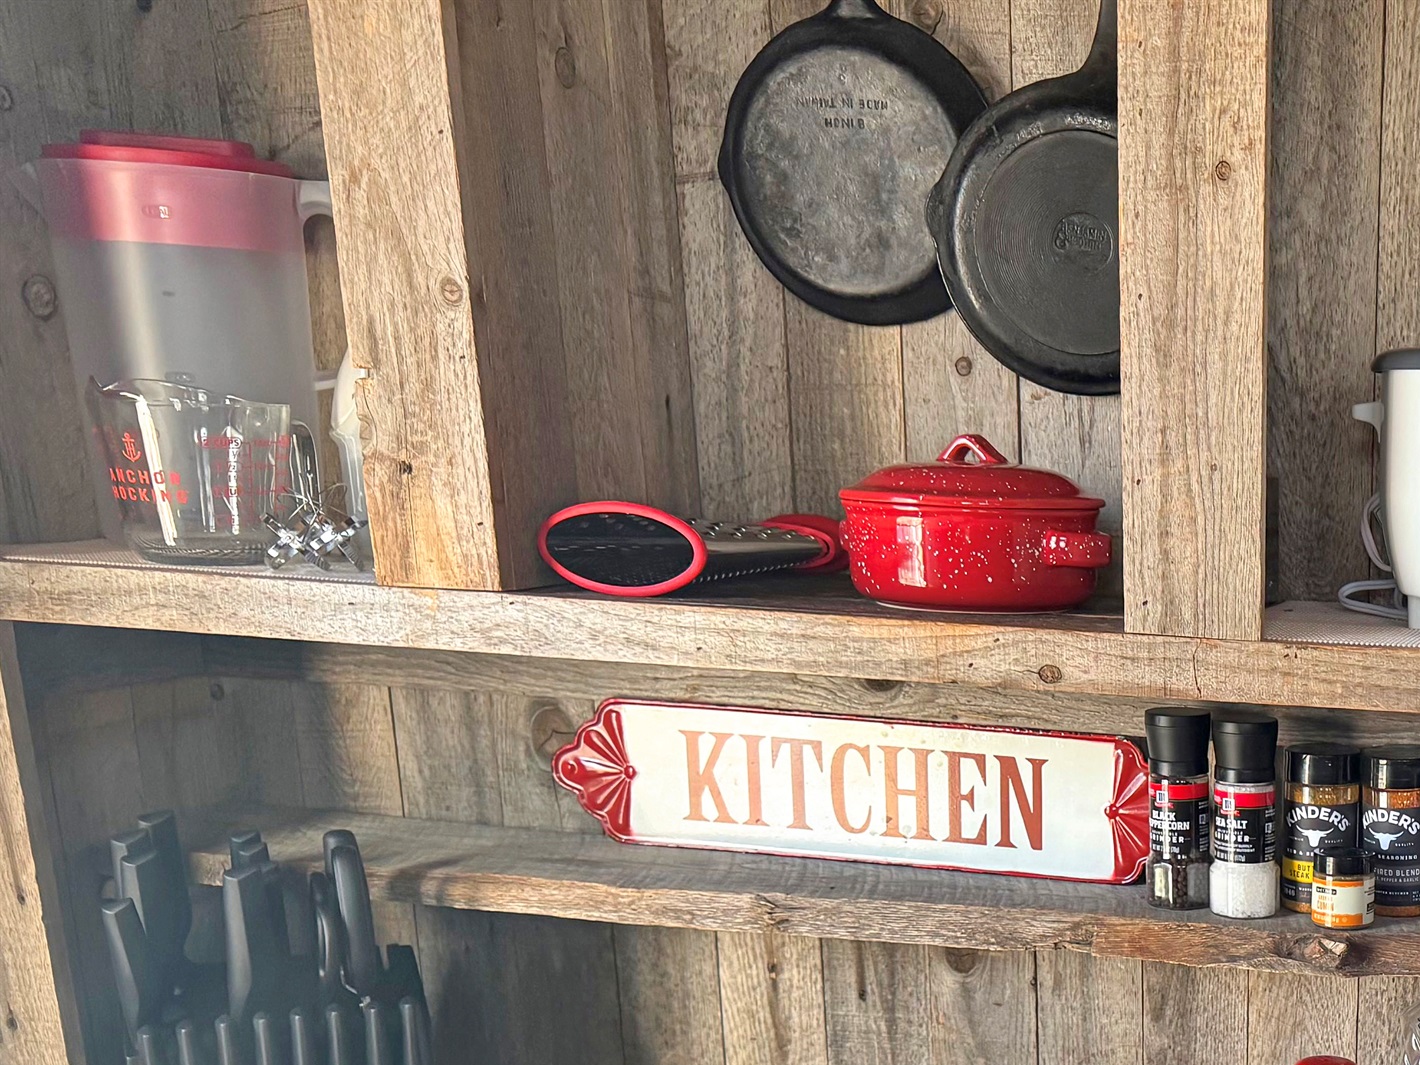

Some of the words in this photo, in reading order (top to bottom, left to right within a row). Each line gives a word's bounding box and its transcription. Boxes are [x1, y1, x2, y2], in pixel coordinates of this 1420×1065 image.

[842, 98, 854, 109] IN
[859, 99, 888, 110] MADE
[825, 118, 854, 129] INCH
[109, 467, 181, 486] ANCHOR
[112, 484, 189, 504] HOCKING
[678, 729, 1049, 851] KITCHEN
[1152, 810, 1176, 821] BLACK
[1286, 805, 1350, 831] KINDER'S
[1363, 808, 1420, 835] KINDER'S
[1215, 816, 1226, 828] SEA
[1226, 818, 1248, 830] SALT
[1289, 869, 1310, 879] STEAK
[1395, 868, 1420, 877] BLEND
